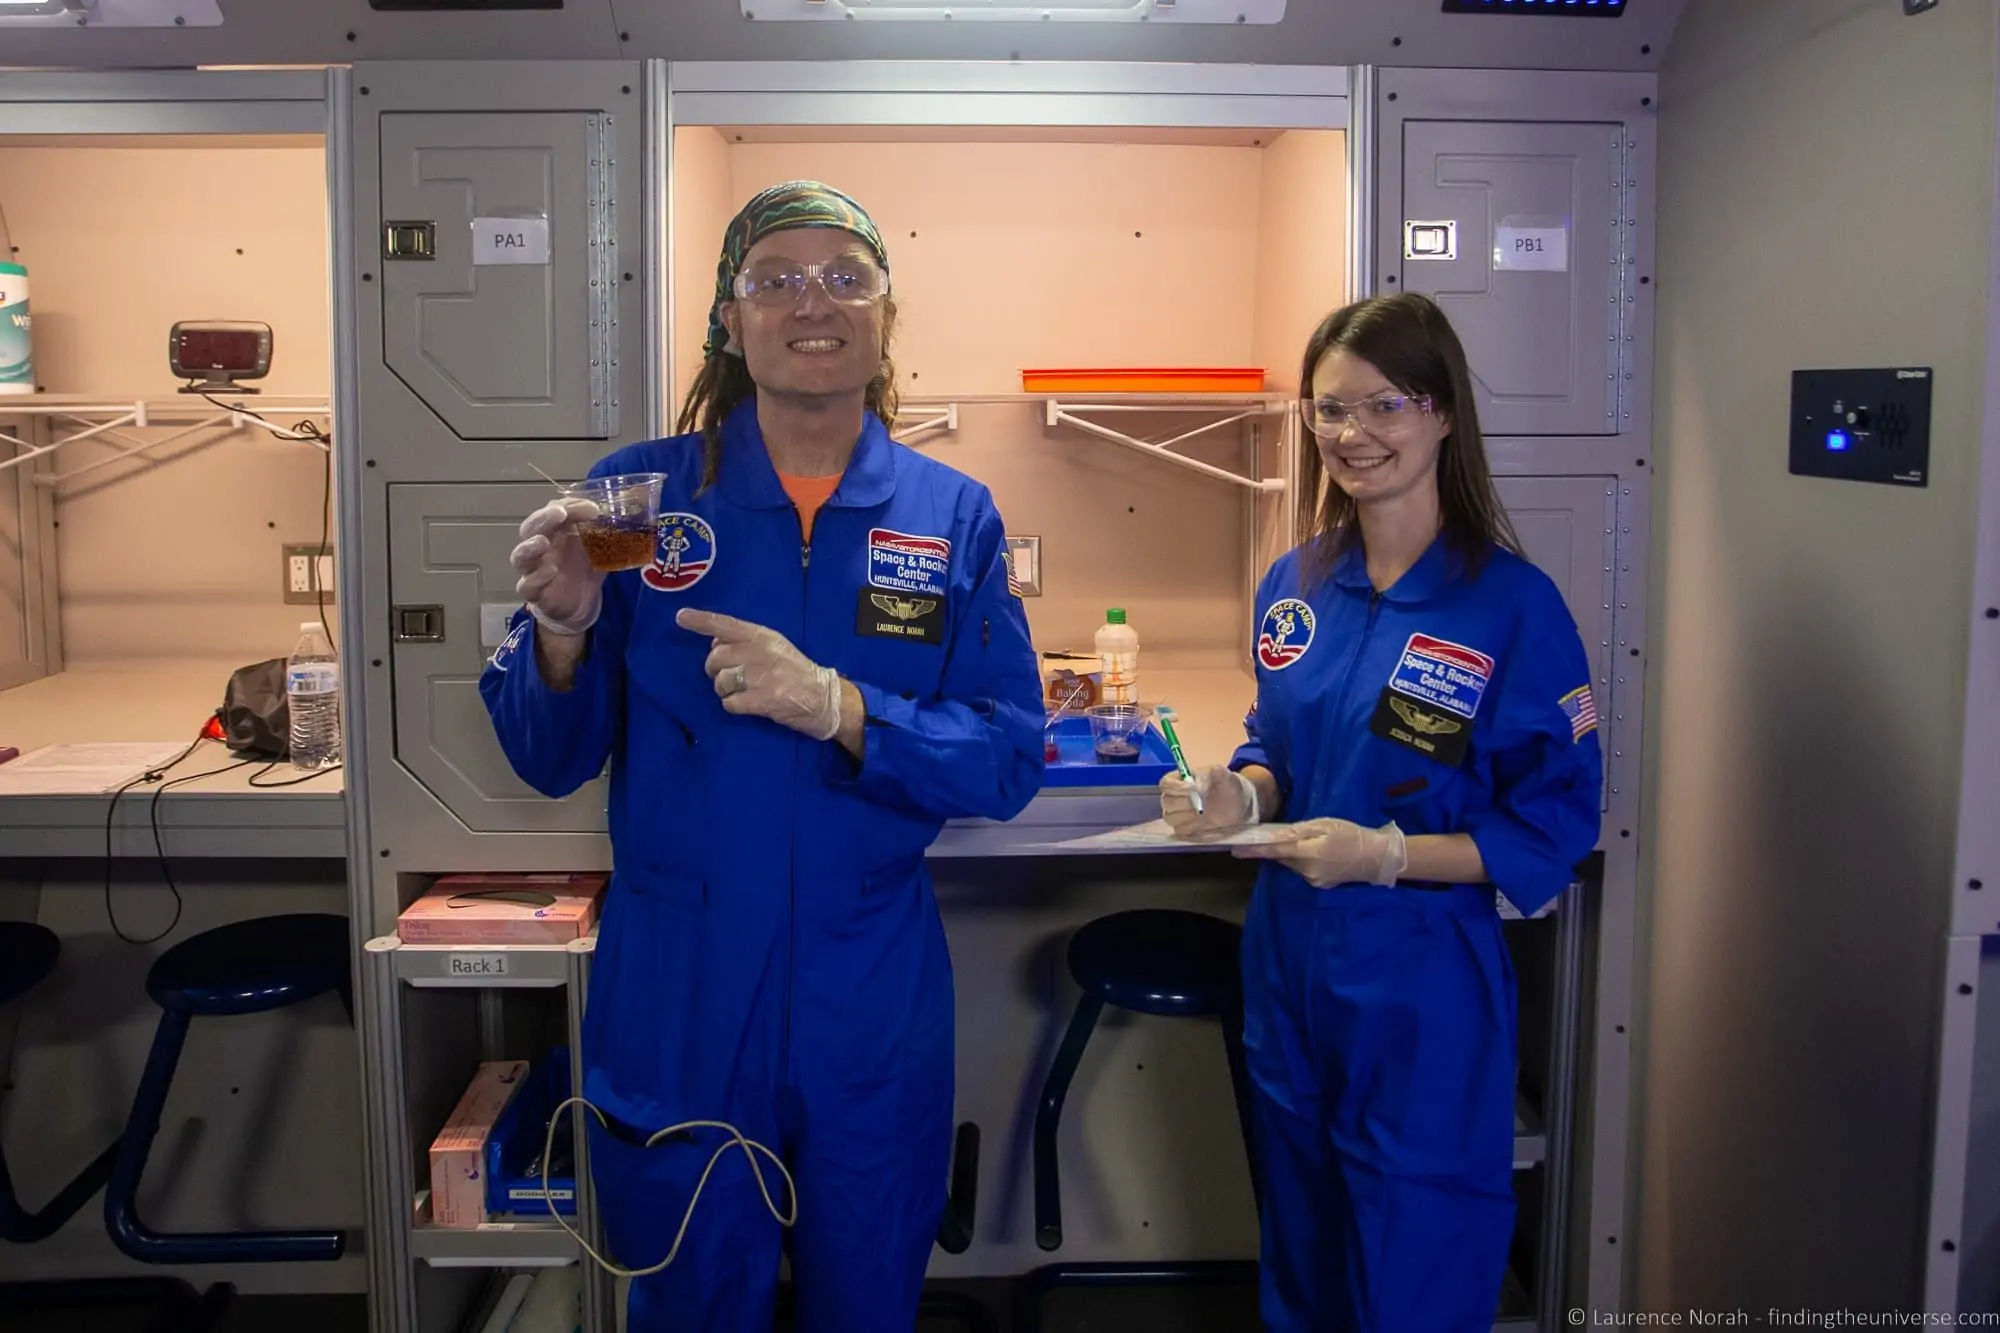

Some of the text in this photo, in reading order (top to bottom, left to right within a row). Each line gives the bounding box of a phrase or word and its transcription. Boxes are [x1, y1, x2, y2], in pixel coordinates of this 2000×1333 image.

[495, 233, 526, 248] PA1
[1515, 238, 1544, 252] PB1
[658, 517, 711, 543] ACE CAMP
[873, 549, 905, 565] Space
[907, 555, 917, 567] &
[874, 574, 918, 591] HUNTSVILLE,
[897, 566, 932, 582] Center
[1271, 603, 1312, 630] SPACE CAMP
[876, 621, 905, 634] LAURENCE
[1404, 654, 1435, 673] Space
[1434, 664, 1445, 677] &
[1420, 673, 1457, 696] Center
[452, 958, 504, 974] Rack 1
